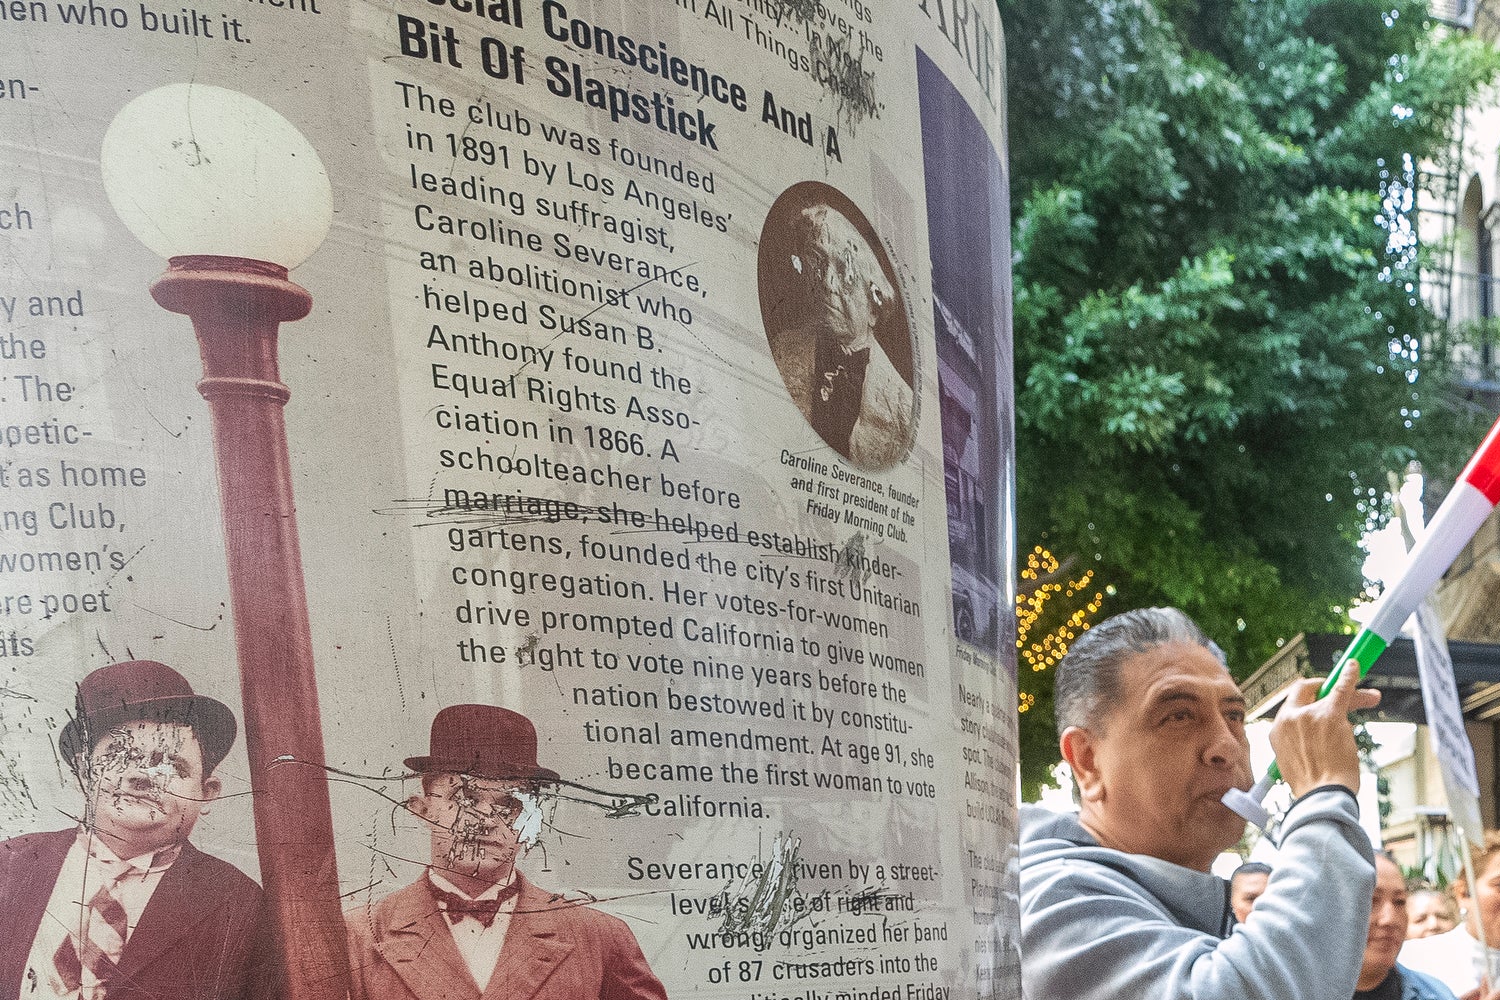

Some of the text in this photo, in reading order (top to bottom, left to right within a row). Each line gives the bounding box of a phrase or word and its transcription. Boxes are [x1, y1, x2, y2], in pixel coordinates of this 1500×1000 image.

[58, 2, 251, 43] who built it.
[705, 0, 734, 31] All
[740, 15, 809, 72] Things
[860, 30, 883, 62] the
[398, 14, 462, 69] Bit
[481, 37, 525, 85] Of
[545, 56, 719, 151] Slapstick
[542, 1, 747, 112] Conscience
[762, 90, 815, 147] And
[826, 126, 842, 163] A
[395, 81, 715, 194] The club was founded
[407, 123, 433, 152] in
[446, 133, 510, 169] 1891
[524, 150, 556, 185] by
[568, 162, 615, 196] Los
[410, 163, 674, 253] leading suffragist,
[415, 204, 707, 298] Caroline Severance,
[29, 290, 84, 316] and
[424, 284, 663, 353] helped Susan B.
[0, 335, 46, 359] the
[427, 325, 691, 394] Anthony found the
[14, 375, 72, 402] The
[432, 364, 700, 429] Equal Rights Asso-
[18, 462, 147, 487] as home
[780, 449, 919, 509] Caroline Severance, founder
[791, 475, 915, 526] and first president of the
[49, 502, 126, 533] Club,
[806, 499, 908, 543] Friday Morning Club.
[43, 588, 111, 615] poet
[457, 599, 530, 627] drive
[542, 610, 673, 639] prompted
[683, 618, 794, 653] California
[801, 636, 820, 657] to
[828, 643, 864, 666] give
[870, 653, 924, 678] women
[572, 683, 913, 734] nation bestowed it by constitu-
[608, 757, 935, 799] became the first woman to vote
